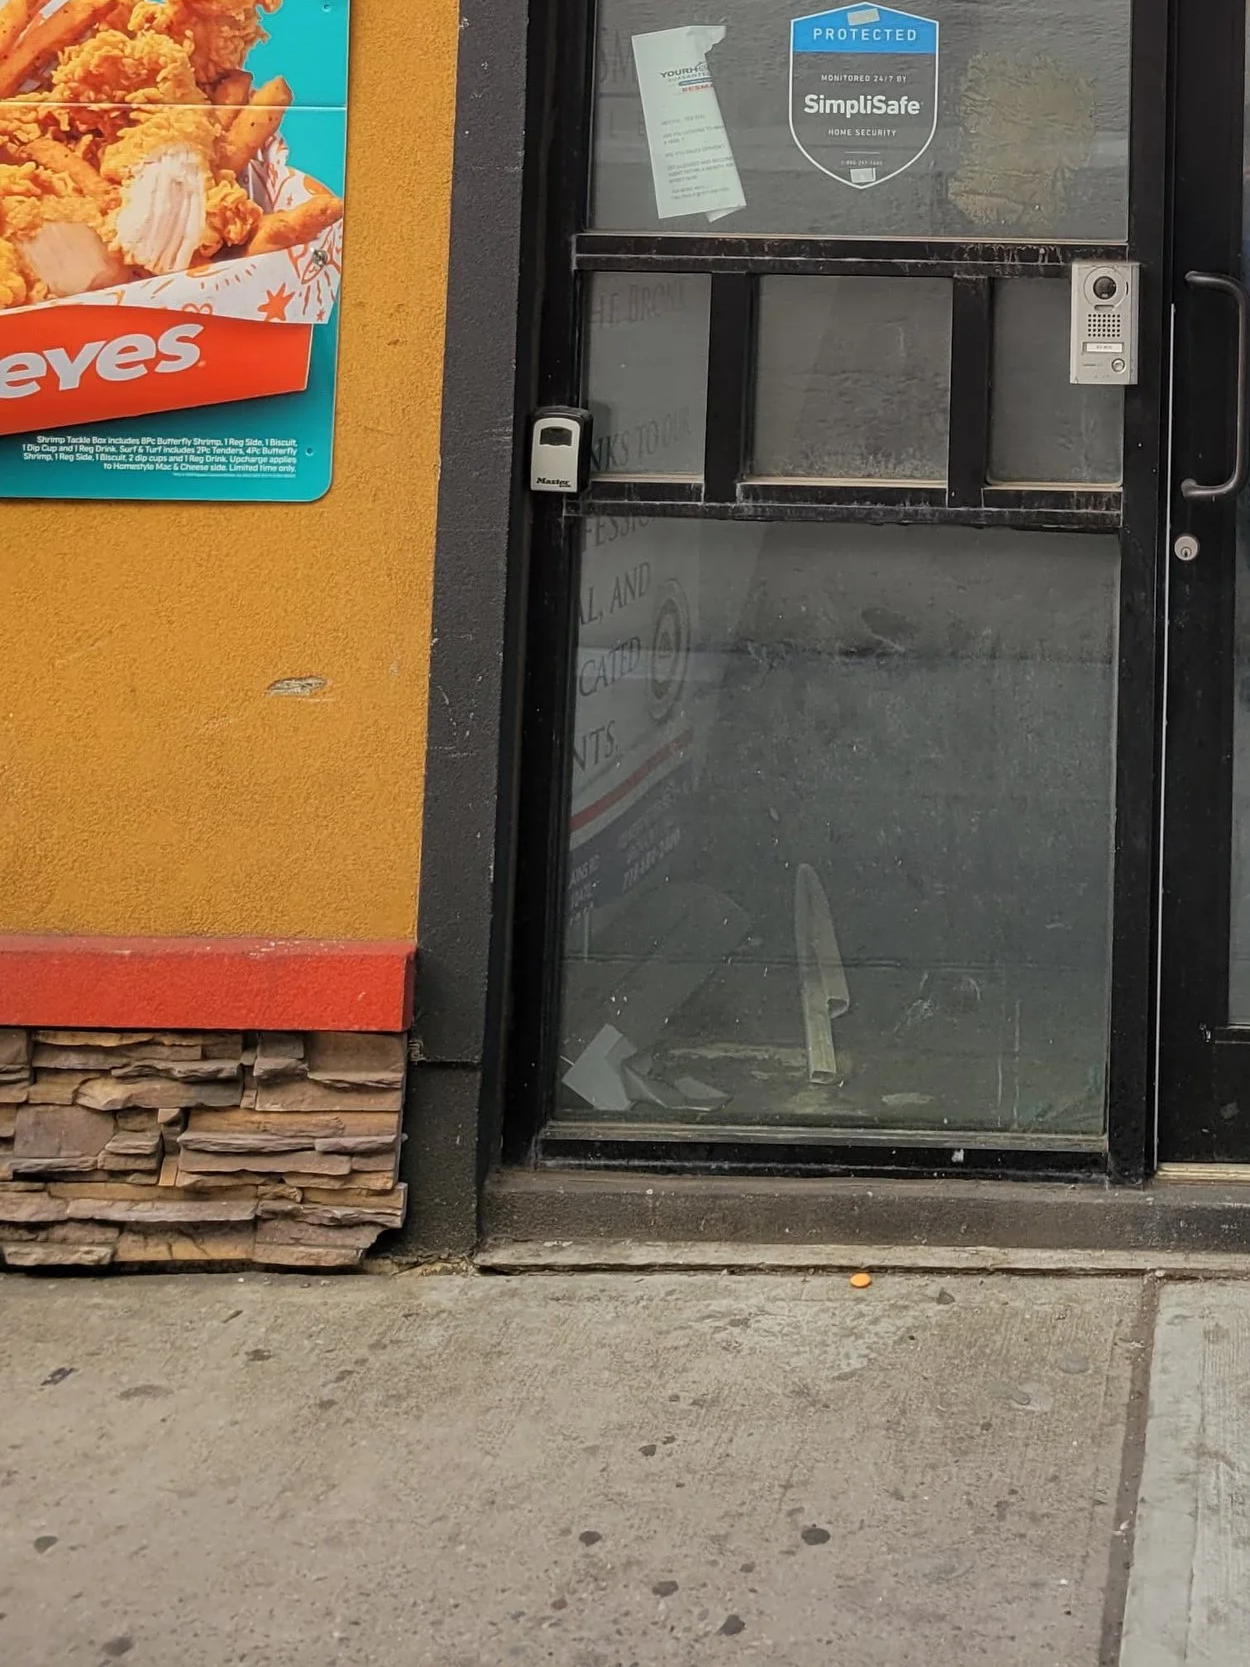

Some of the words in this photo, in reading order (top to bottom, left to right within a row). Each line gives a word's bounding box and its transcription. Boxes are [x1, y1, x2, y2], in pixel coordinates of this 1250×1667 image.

[813, 27, 917, 41] PROTECTED
[821, 74, 871, 82] MONITORED
[804, 94, 921, 118] SimpliSafe
[855, 129, 897, 137] SECURITY
[37, 436, 65, 445] Shrimp
[67, 436, 91, 444] Tackle
[92, 436, 107, 444] Box
[108, 437, 140, 445] includes
[27, 444, 40, 453] Dip
[41, 444, 57, 453] Cup
[79, 445, 94, 454] Reg
[145, 446, 162, 454] Turf
[163, 446, 195, 454] includes
[59, 453, 75, 462] Reg
[134, 454, 148, 463] dip
[148, 455, 167, 463] cups
[189, 455, 204, 464] Reg
[113, 463, 155, 472] Homestyle
[609, 561, 651, 614] AND
